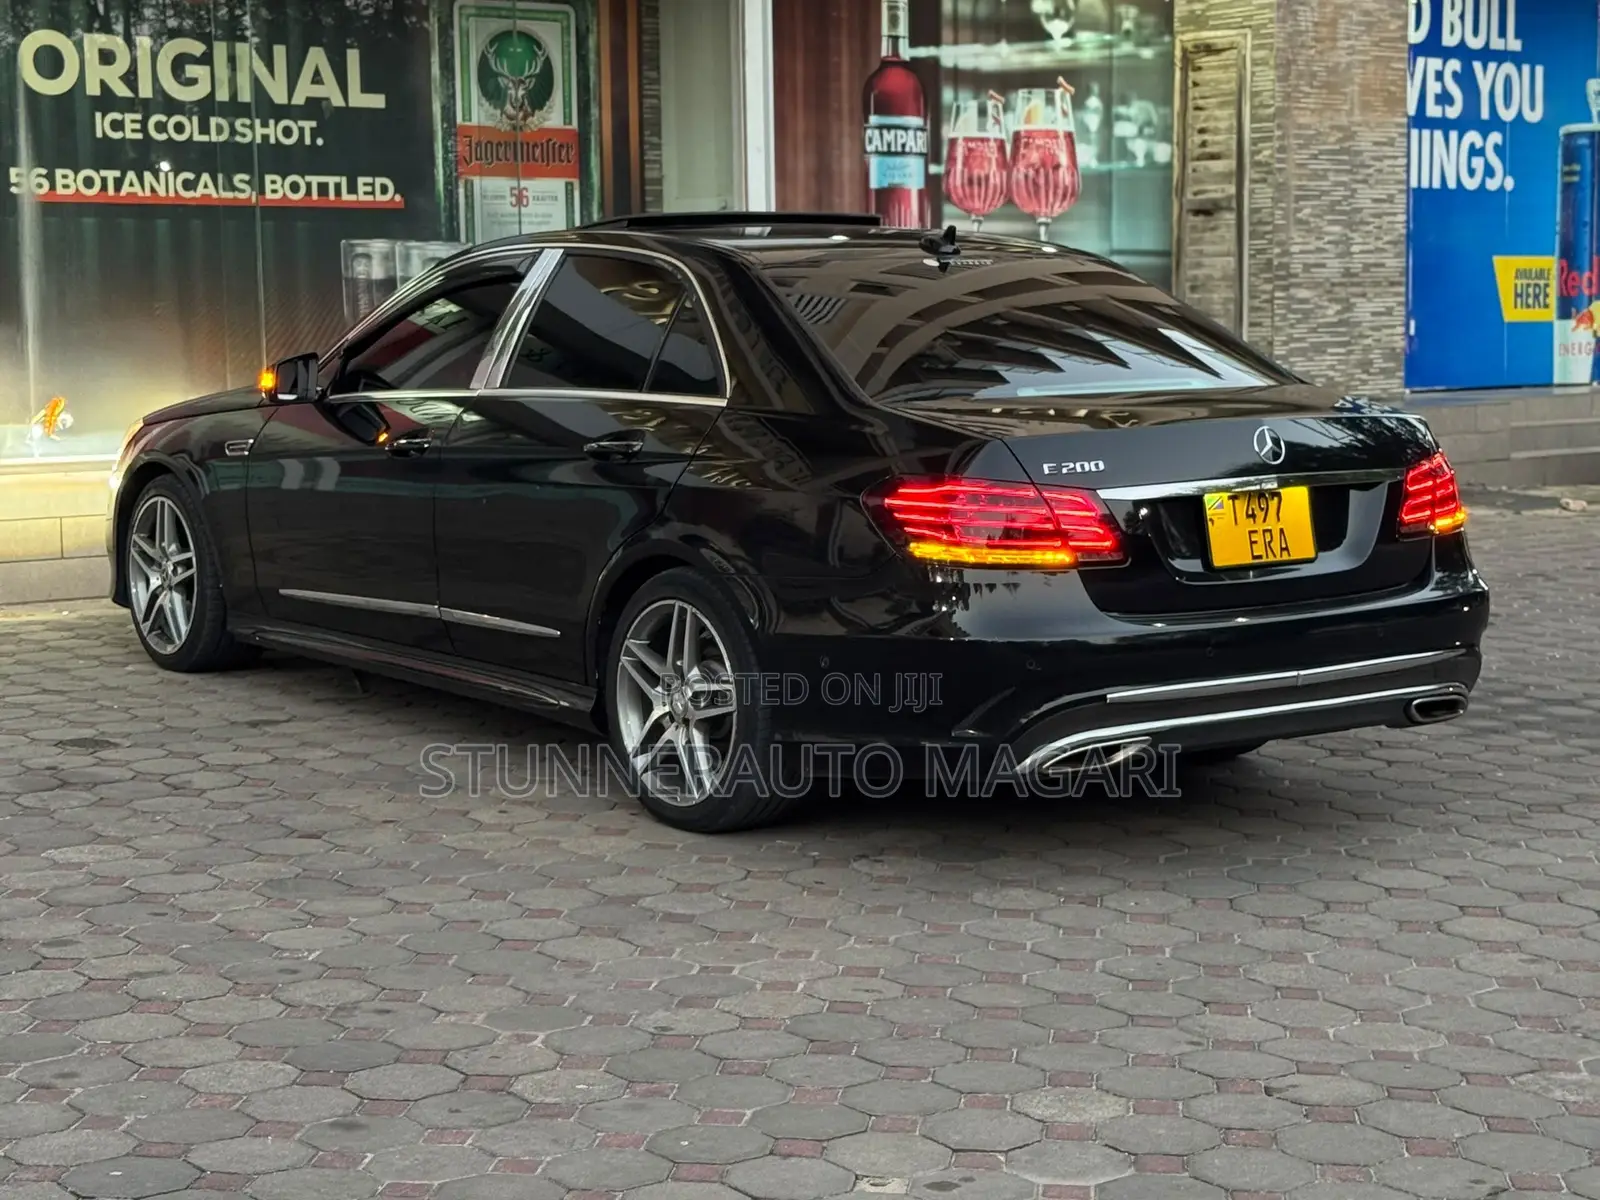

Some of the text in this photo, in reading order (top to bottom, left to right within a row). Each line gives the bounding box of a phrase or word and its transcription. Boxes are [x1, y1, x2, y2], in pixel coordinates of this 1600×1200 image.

[1441, 0, 1523, 52] BULL
[19, 29, 386, 109] ORIGINAL
[1472, 60, 1545, 123] YOU
[94, 112, 325, 146] ICE COLD SHOT.
[865, 128, 928, 153] CAMPARI
[9, 167, 402, 204] 56 BOTANICALS, BOTTLED.
[509, 186, 530, 208] 56
[1557, 255, 1599, 297] Red
[1513, 282, 1551, 309] HERE
[1042, 460, 1105, 475] E 200
[1247, 527, 1292, 560] ERA
